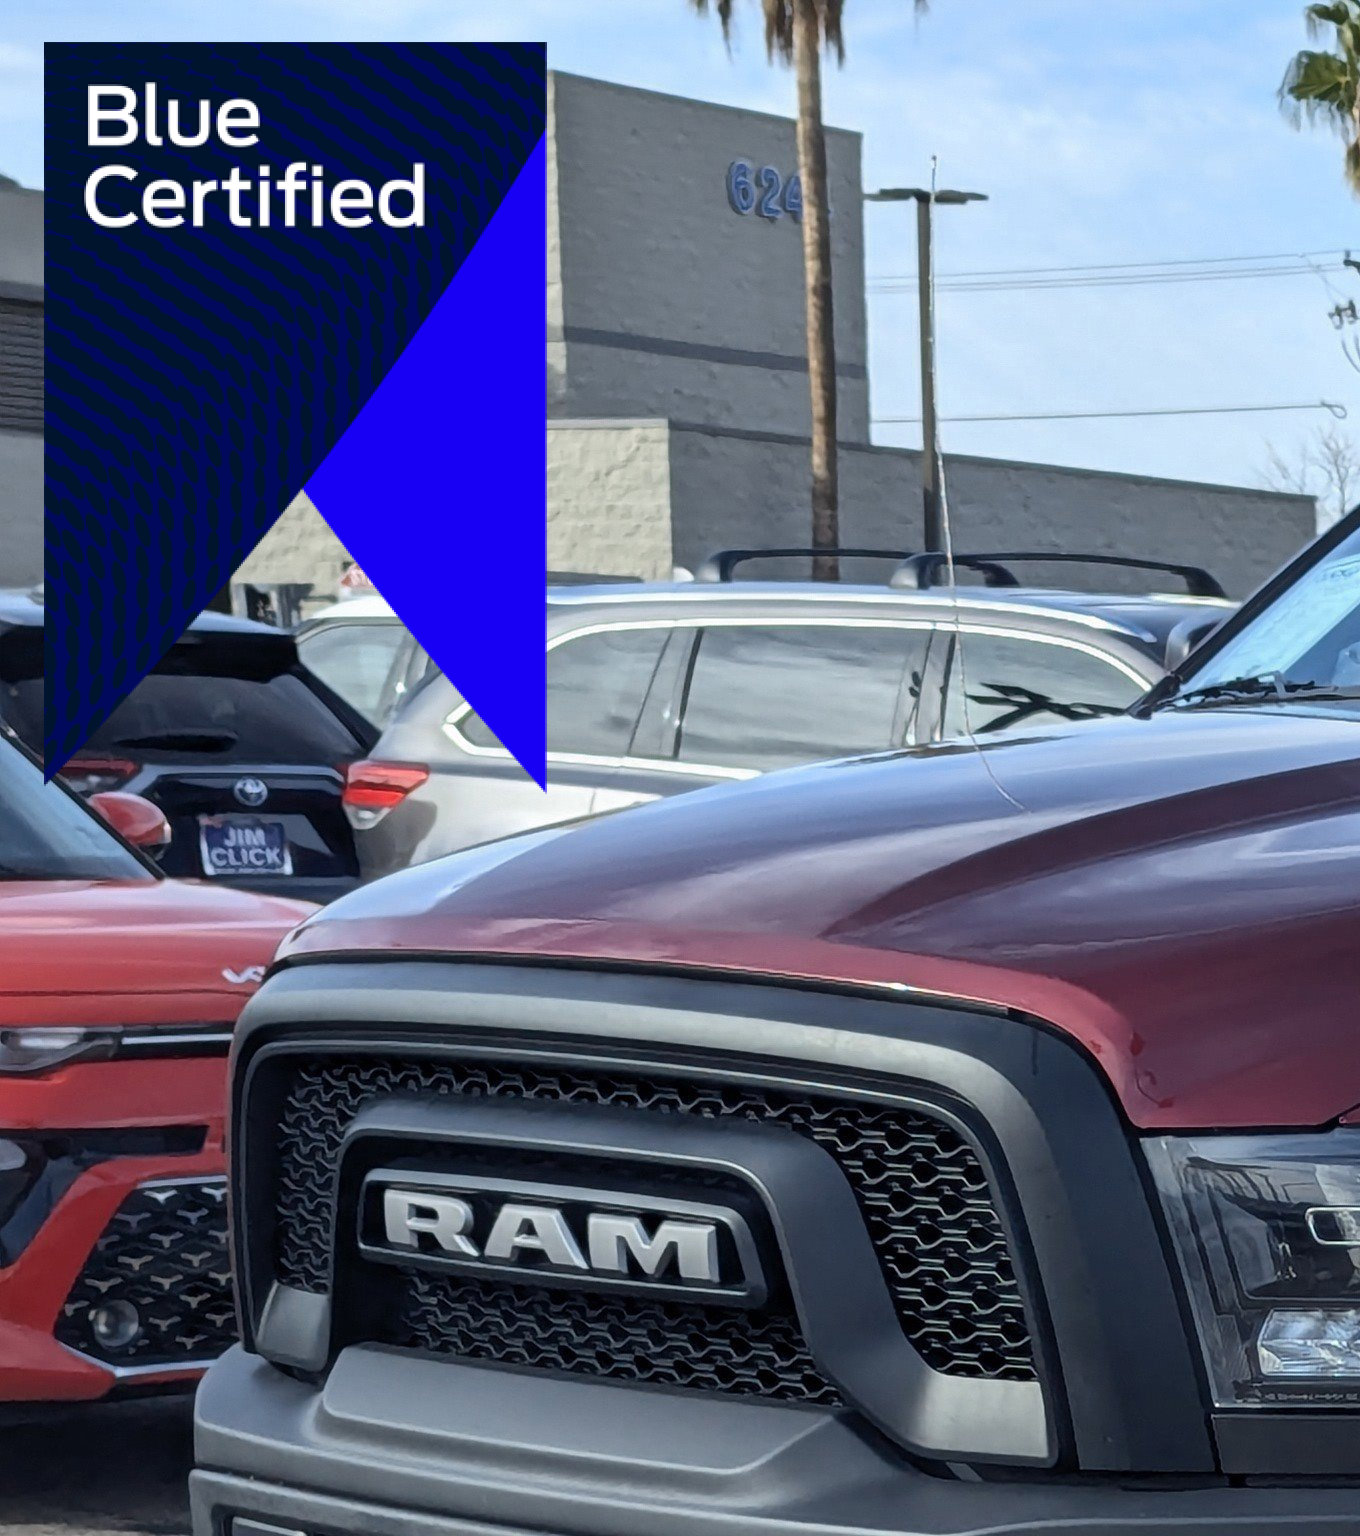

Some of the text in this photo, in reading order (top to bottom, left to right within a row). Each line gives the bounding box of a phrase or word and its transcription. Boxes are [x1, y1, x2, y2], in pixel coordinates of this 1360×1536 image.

[728, 160, 833, 220] 624
[210, 846, 282, 867] CLICK
[223, 826, 266, 847] JIM
[384, 1188, 721, 1284] RAM
